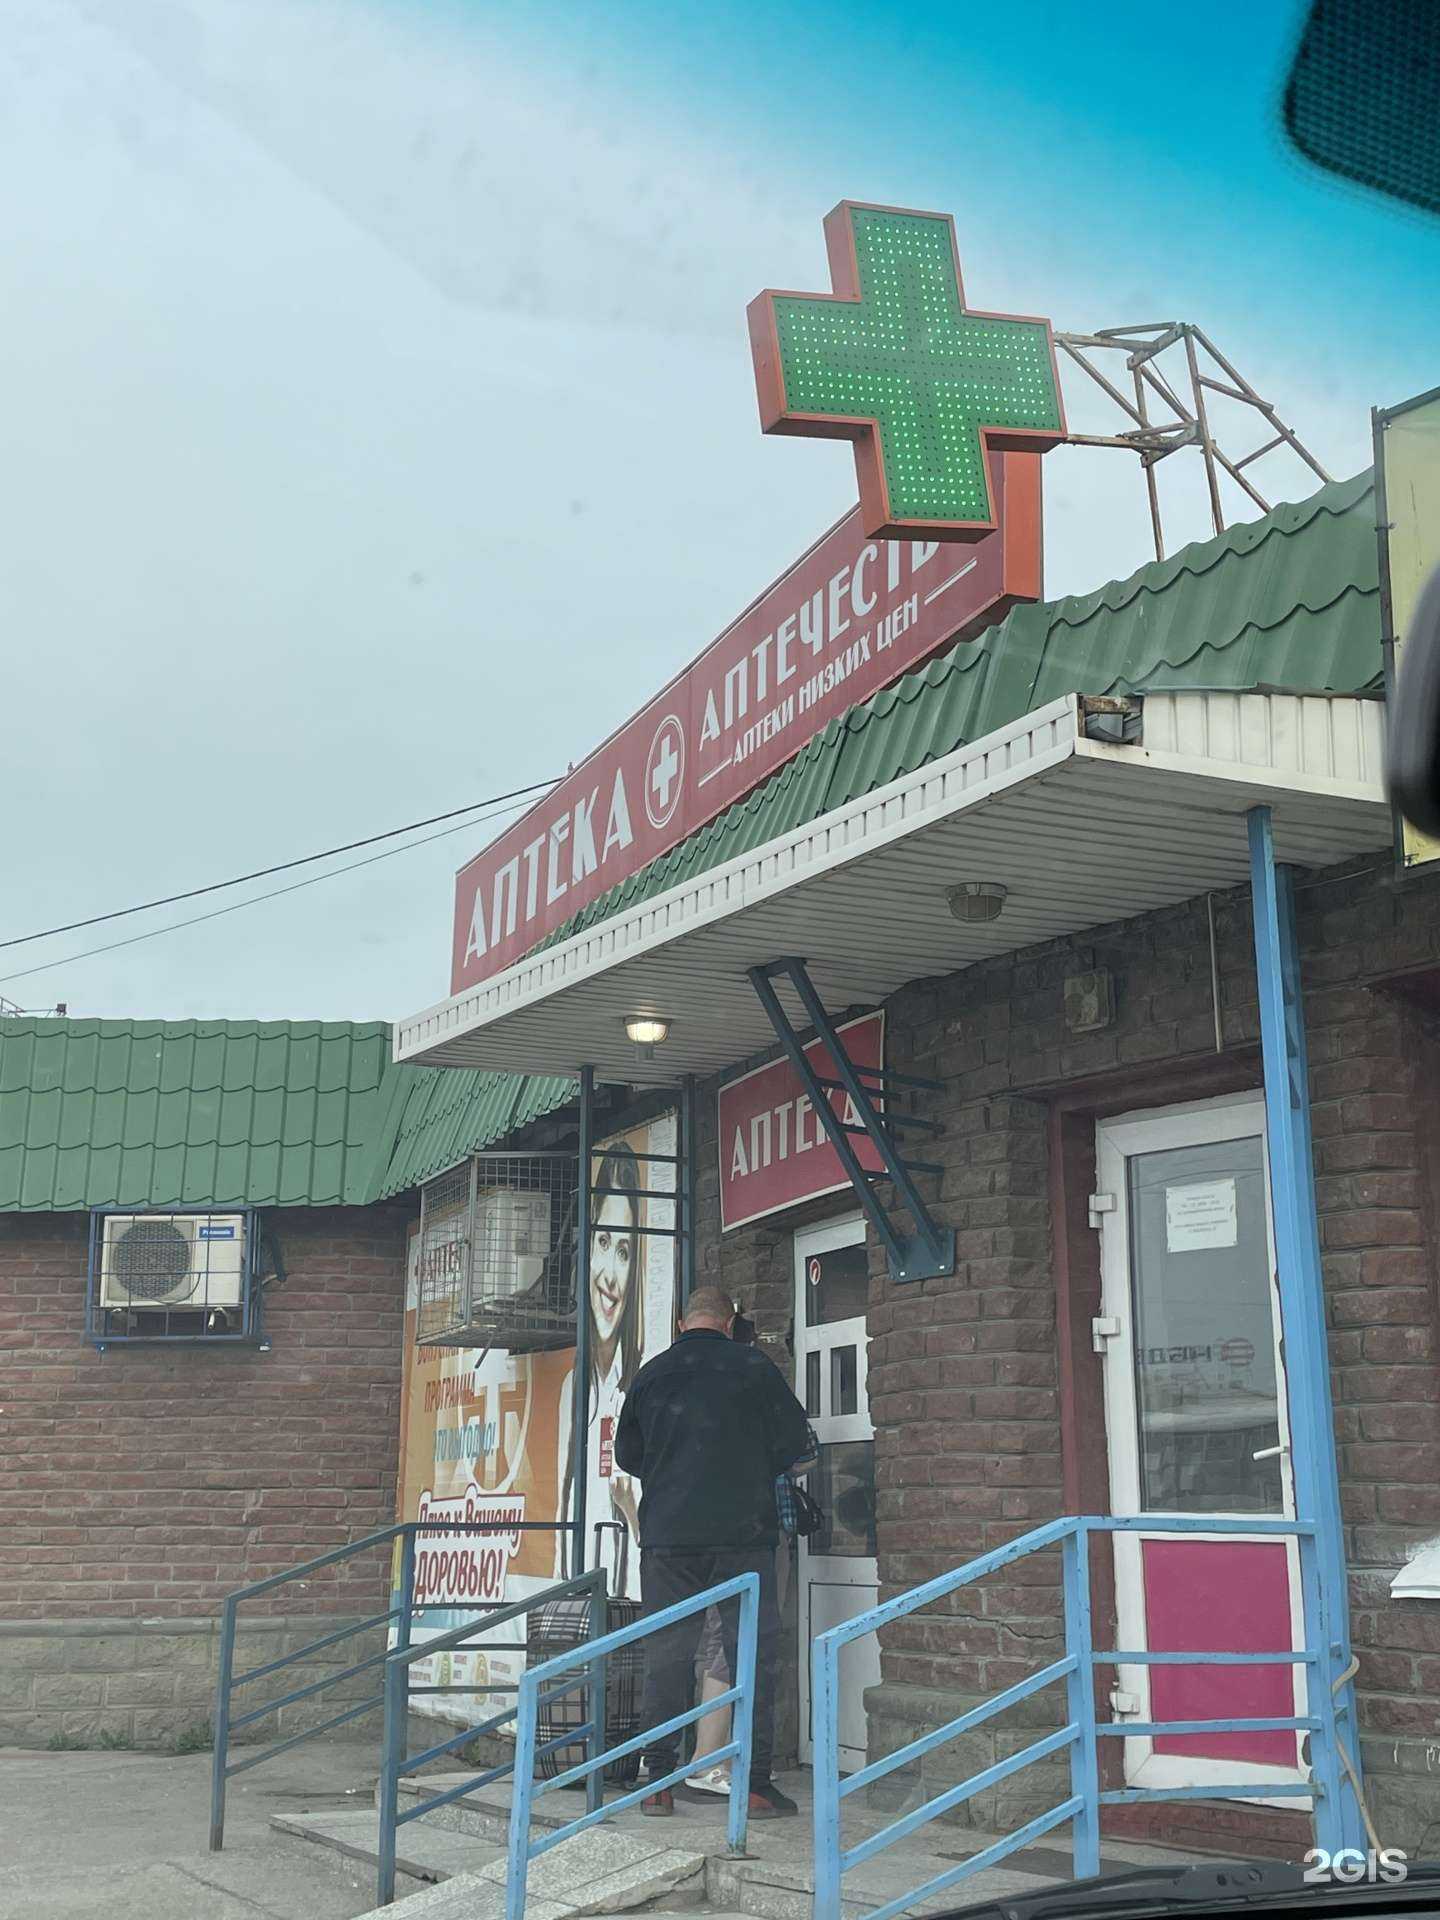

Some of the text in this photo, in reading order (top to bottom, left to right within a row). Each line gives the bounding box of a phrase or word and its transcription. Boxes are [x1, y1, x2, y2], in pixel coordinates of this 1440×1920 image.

[733, 593, 918, 765] АПТЕКИ НИЗКИХ ЦЕН
[464, 767, 633, 968] АПТЕКА
[414, 1549, 503, 1606] ДОРОВЬЮ!
